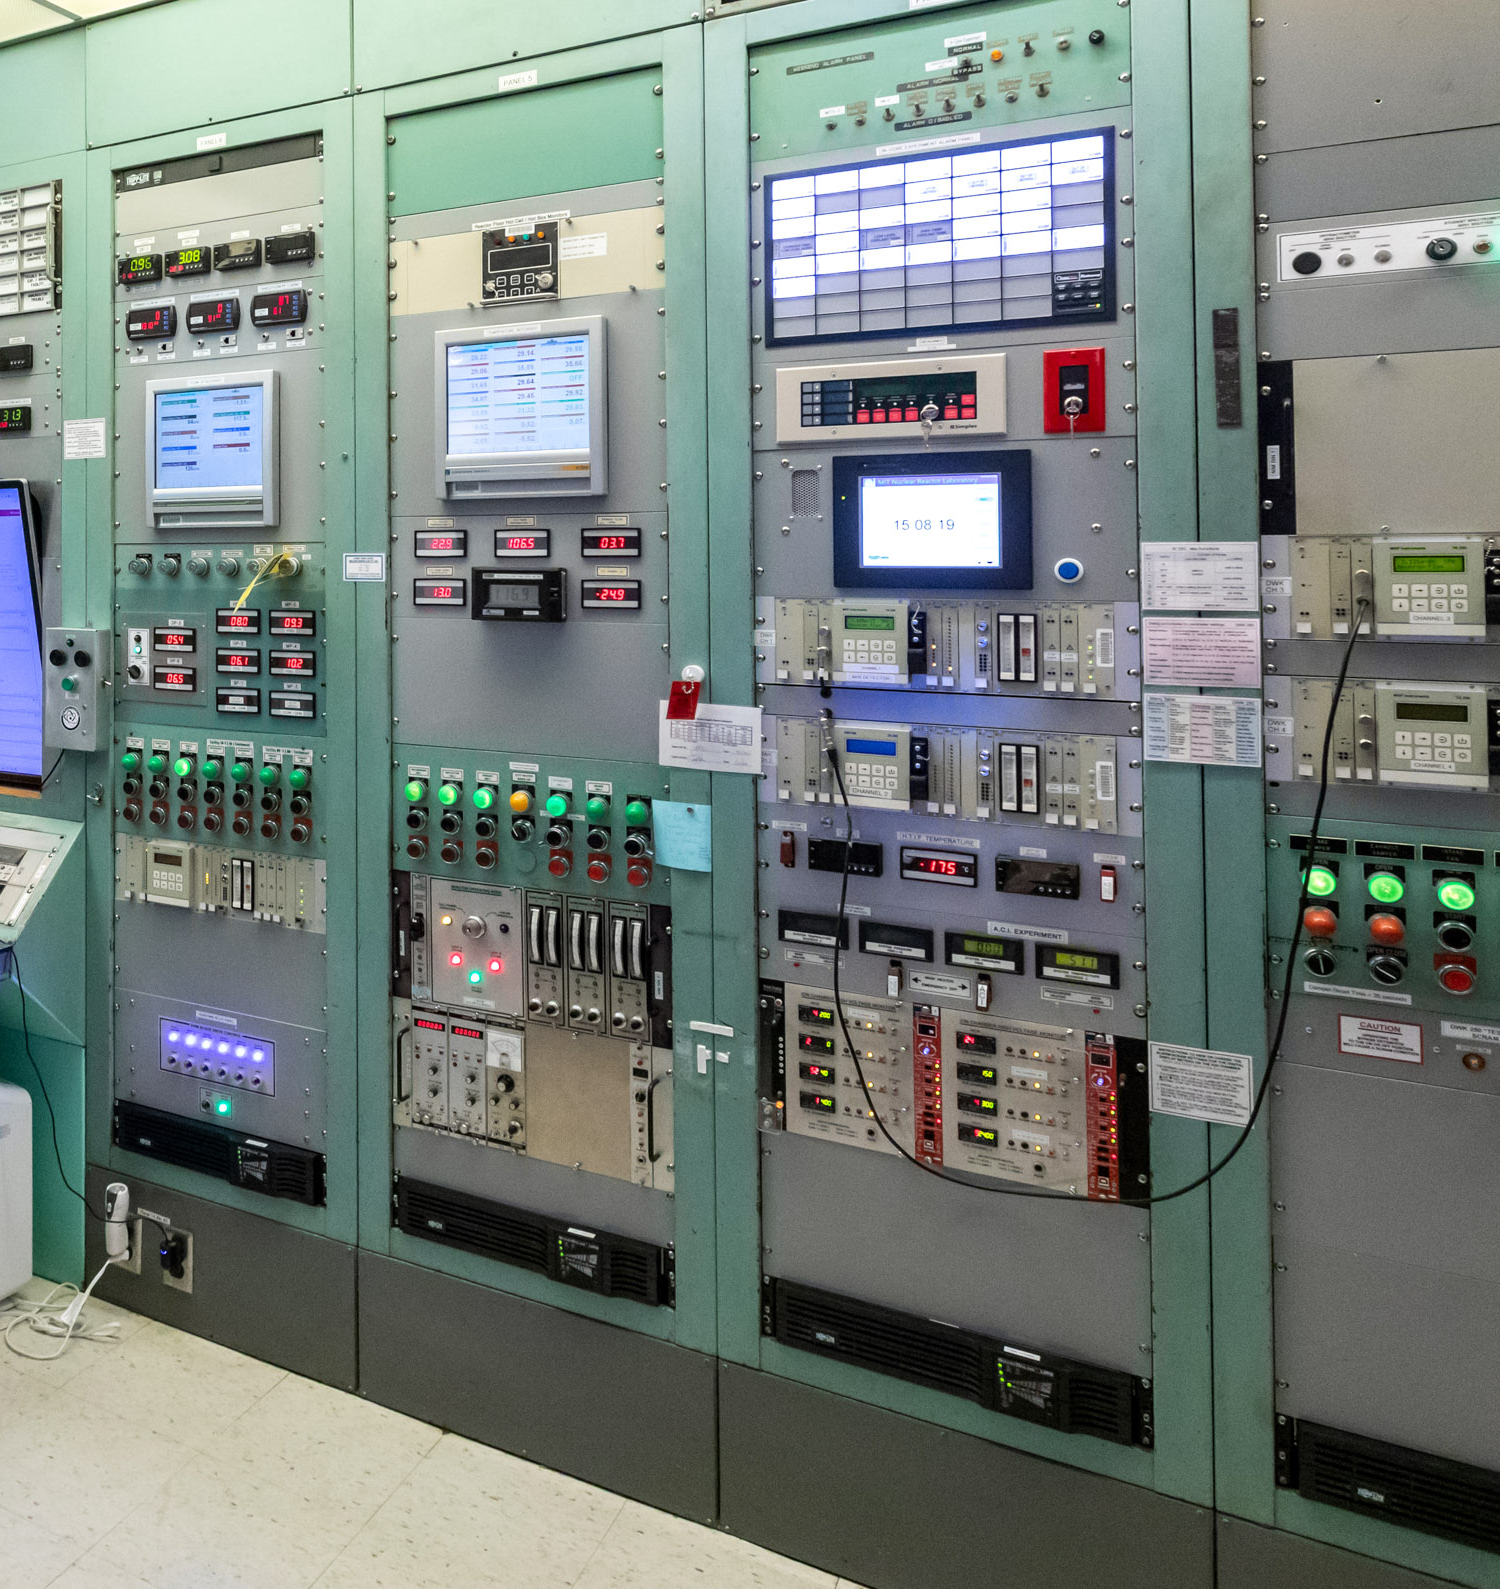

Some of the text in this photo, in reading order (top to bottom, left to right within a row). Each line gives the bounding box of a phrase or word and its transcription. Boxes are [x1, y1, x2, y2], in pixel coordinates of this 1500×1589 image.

[953, 43, 982, 53] NORMAL
[792, 53, 867, 73] WEEKEND ALARM PANEL
[953, 65, 982, 76] BYPASS
[503, 75, 533, 87] PANEL 5
[906, 76, 960, 90] ALARM NORMAL
[903, 113, 963, 129] ALARM DISABLED
[178, 249, 201, 265] 3.08
[130, 257, 152, 272] 0.96
[517, 377, 535, 386] 29.64
[569, 374, 583, 382] OFF
[3, 409, 22, 422] 31.3
[917, 477, 941, 485] Reactor
[942, 477, 979, 486] Laboratory
[915, 519, 932, 531] 08
[430, 538, 453, 549] 22.9
[507, 537, 535, 549] 106.5
[600, 537, 625, 548] 03.7
[1265, 579, 1284, 587] DWK
[432, 587, 452, 598] 13.0
[1265, 586, 1276, 594] CH
[230, 616, 249, 627] 08.0
[283, 617, 303, 628] 09.3
[1412, 614, 1443, 622] CHANNEL
[166, 634, 184, 645] 05.4
[230, 655, 249, 666] 06.1
[286, 658, 304, 669] 10.2
[166, 673, 184, 684] 06.5
[1267, 719, 1287, 727] DWK
[1413, 761, 1445, 770] CHANNEL
[852, 787, 883, 796] CHANNEL
[924, 834, 976, 847] TEMPERATURE
[1374, 863, 1394, 871] OPEN
[1013, 928, 1063, 940] EXPERIMENT
[1359, 1021, 1401, 1033] CAUTION
[1450, 1023, 1468, 1031] DWK
[1471, 1033, 1500, 1042] SCRAM
